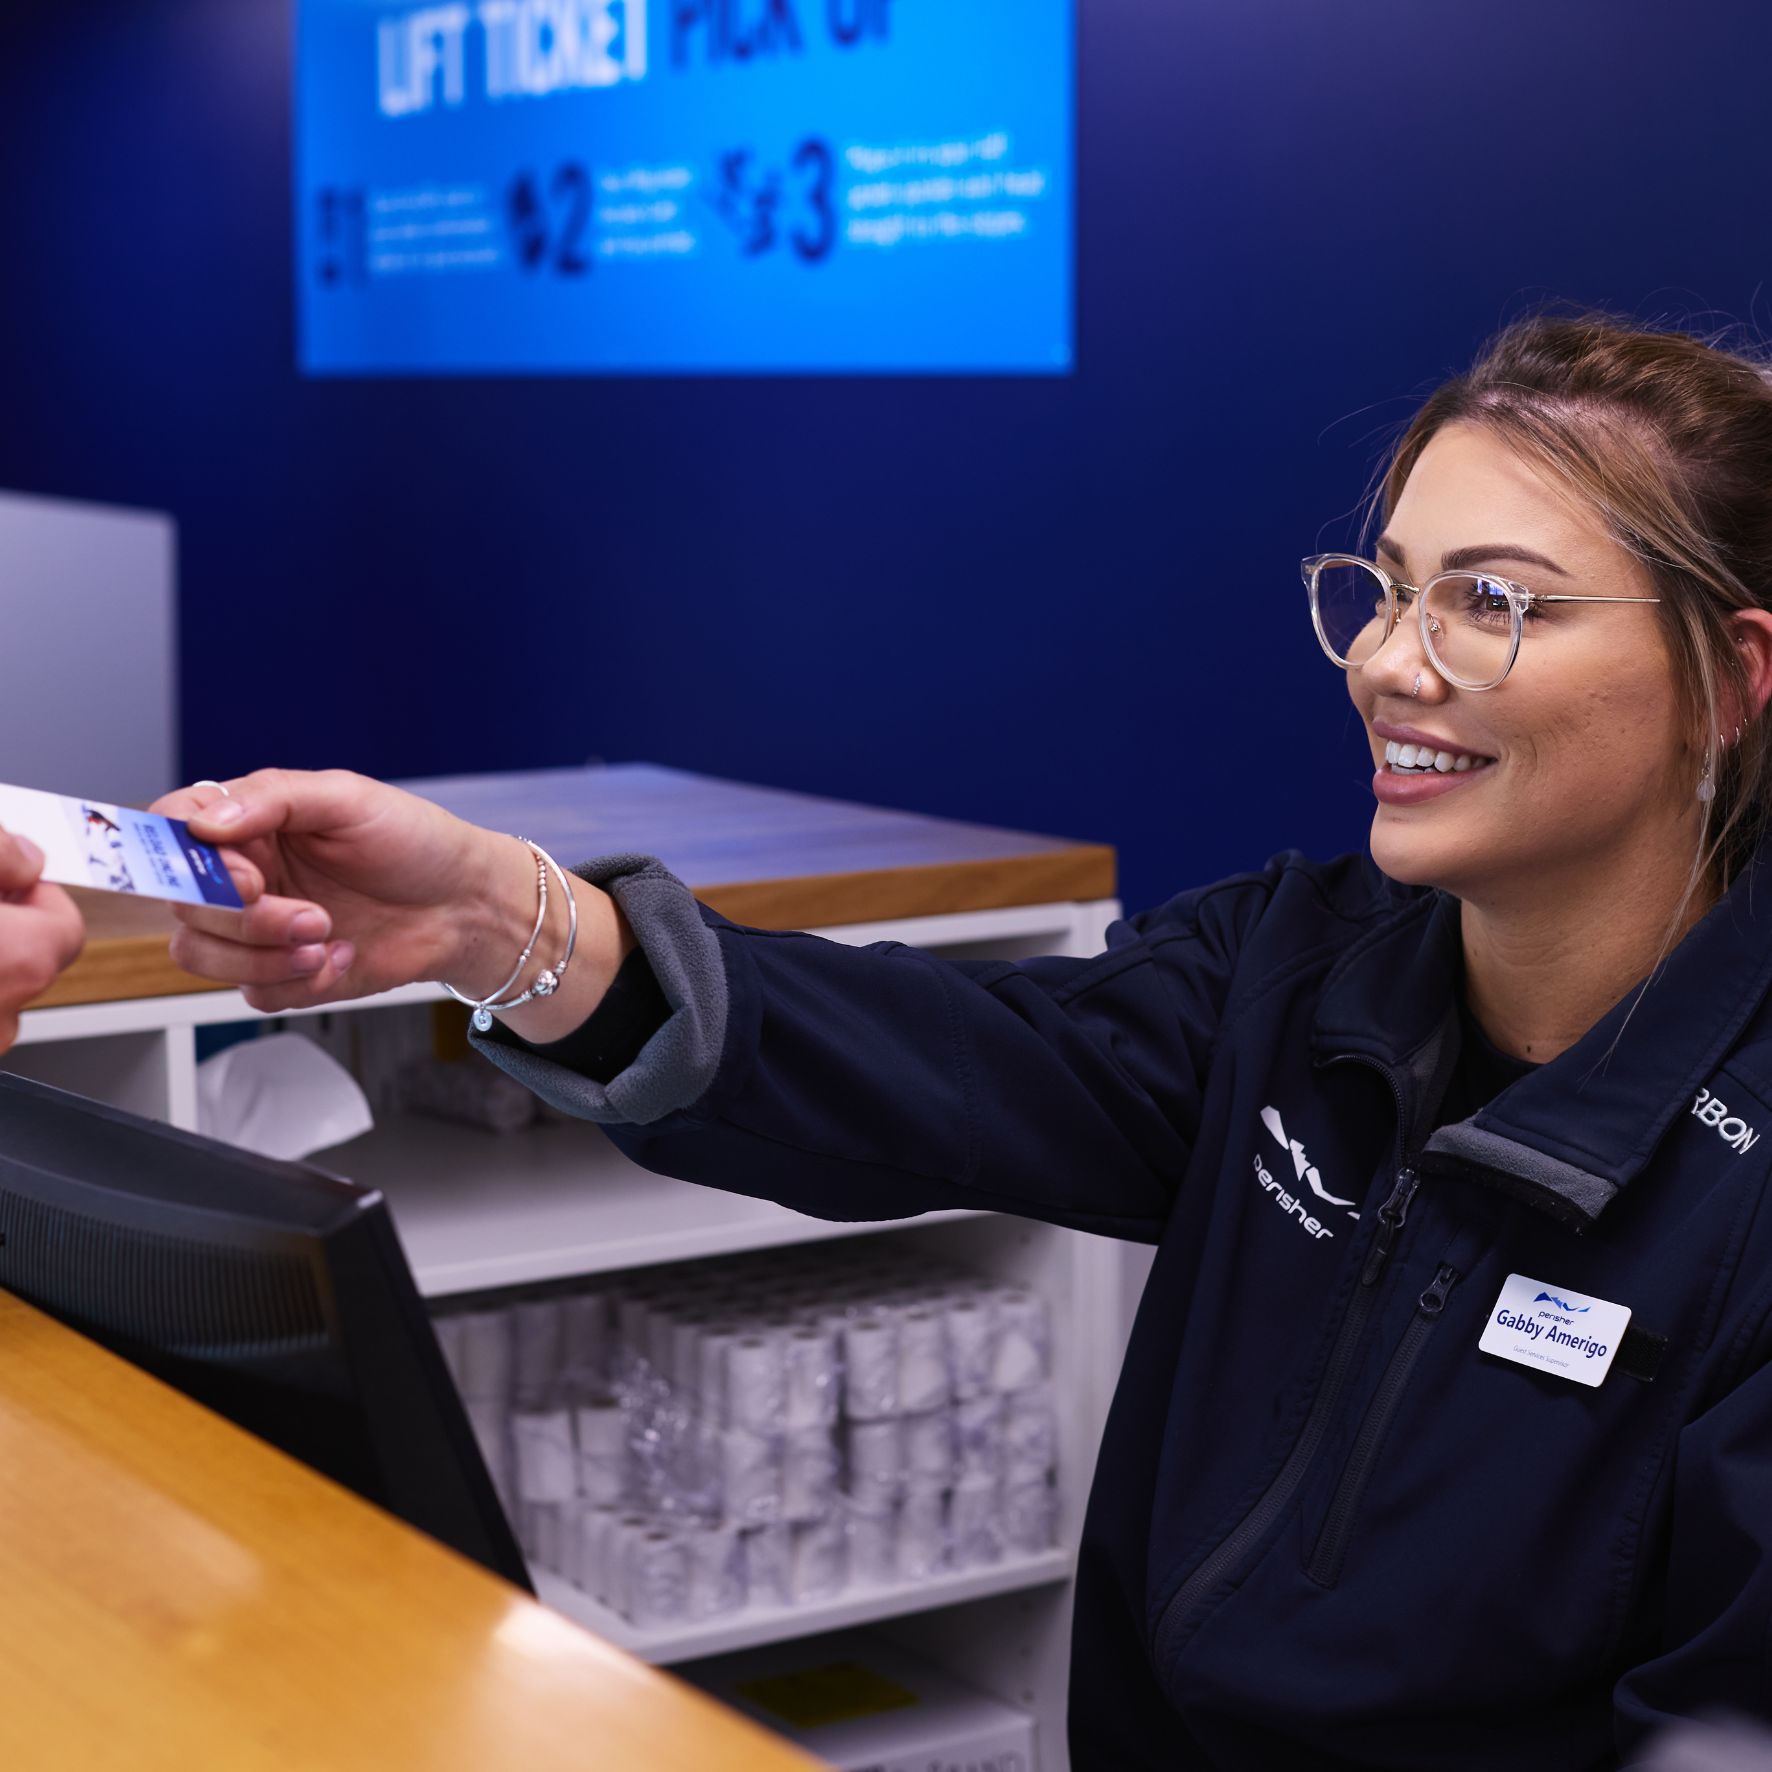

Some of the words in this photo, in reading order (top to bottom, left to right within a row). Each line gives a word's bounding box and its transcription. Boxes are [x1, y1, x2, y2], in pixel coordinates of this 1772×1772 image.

[378, 3, 467, 117] LIFT
[478, 0, 648, 99] TICKET
[550, 160, 595, 276] 2
[790, 138, 838, 265] 3
[1496, 1309, 1545, 1341] Gabby
[1545, 1325, 1608, 1359] Amerigo
[1538, 1311, 1575, 1326] perisher
